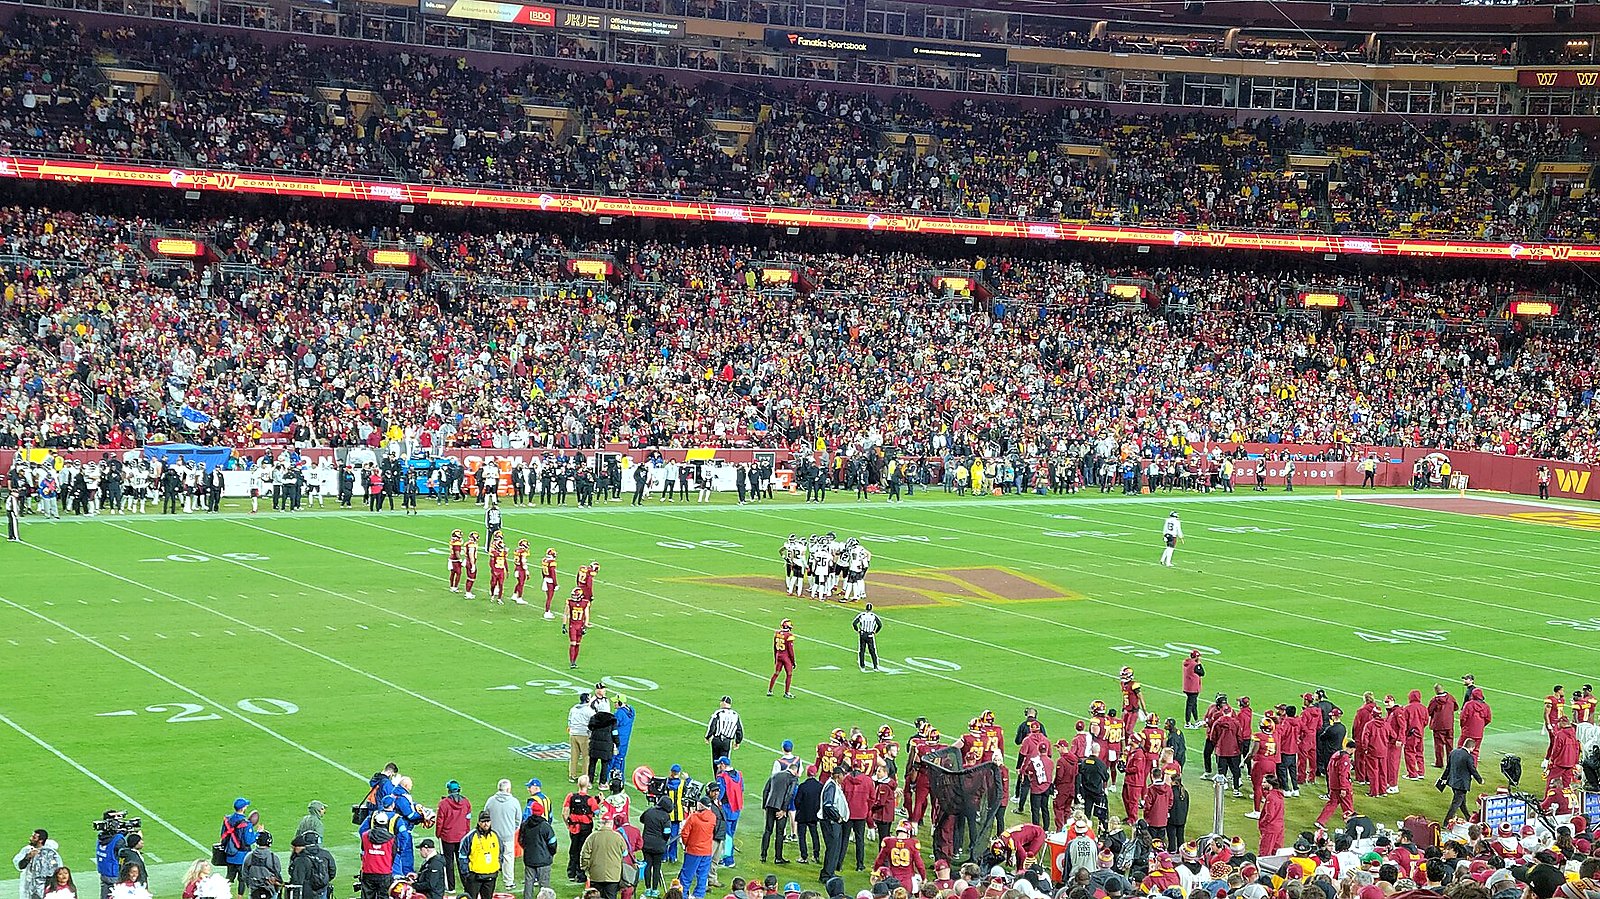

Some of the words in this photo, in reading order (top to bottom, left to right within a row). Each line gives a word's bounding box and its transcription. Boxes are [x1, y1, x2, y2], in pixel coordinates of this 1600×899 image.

[461, 6, 488, 14] Accountants
[531, 11, 551, 21] BDO
[610, 17, 628, 25] Official
[620, 25, 652, 34] Management
[798, 37, 827, 48] Fanatics
[827, 40, 867, 51] Sportsbook
[1536, 73, 1558, 86] W
[1577, 73, 1599, 86] W
[108, 171, 161, 180] FALCONS
[243, 180, 316, 190] COMMANDERS
[603, 204, 668, 212] COMMANDERS
[1303, 469, 1334, 478] 1991
[1555, 468, 1592, 494] W
[1546, 618, 1600, 631] 3
[525, 675, 659, 696] 30
[145, 697, 299, 723] 20
[822, 756, 838, 772] 86
[890, 847, 911, 867] 69
